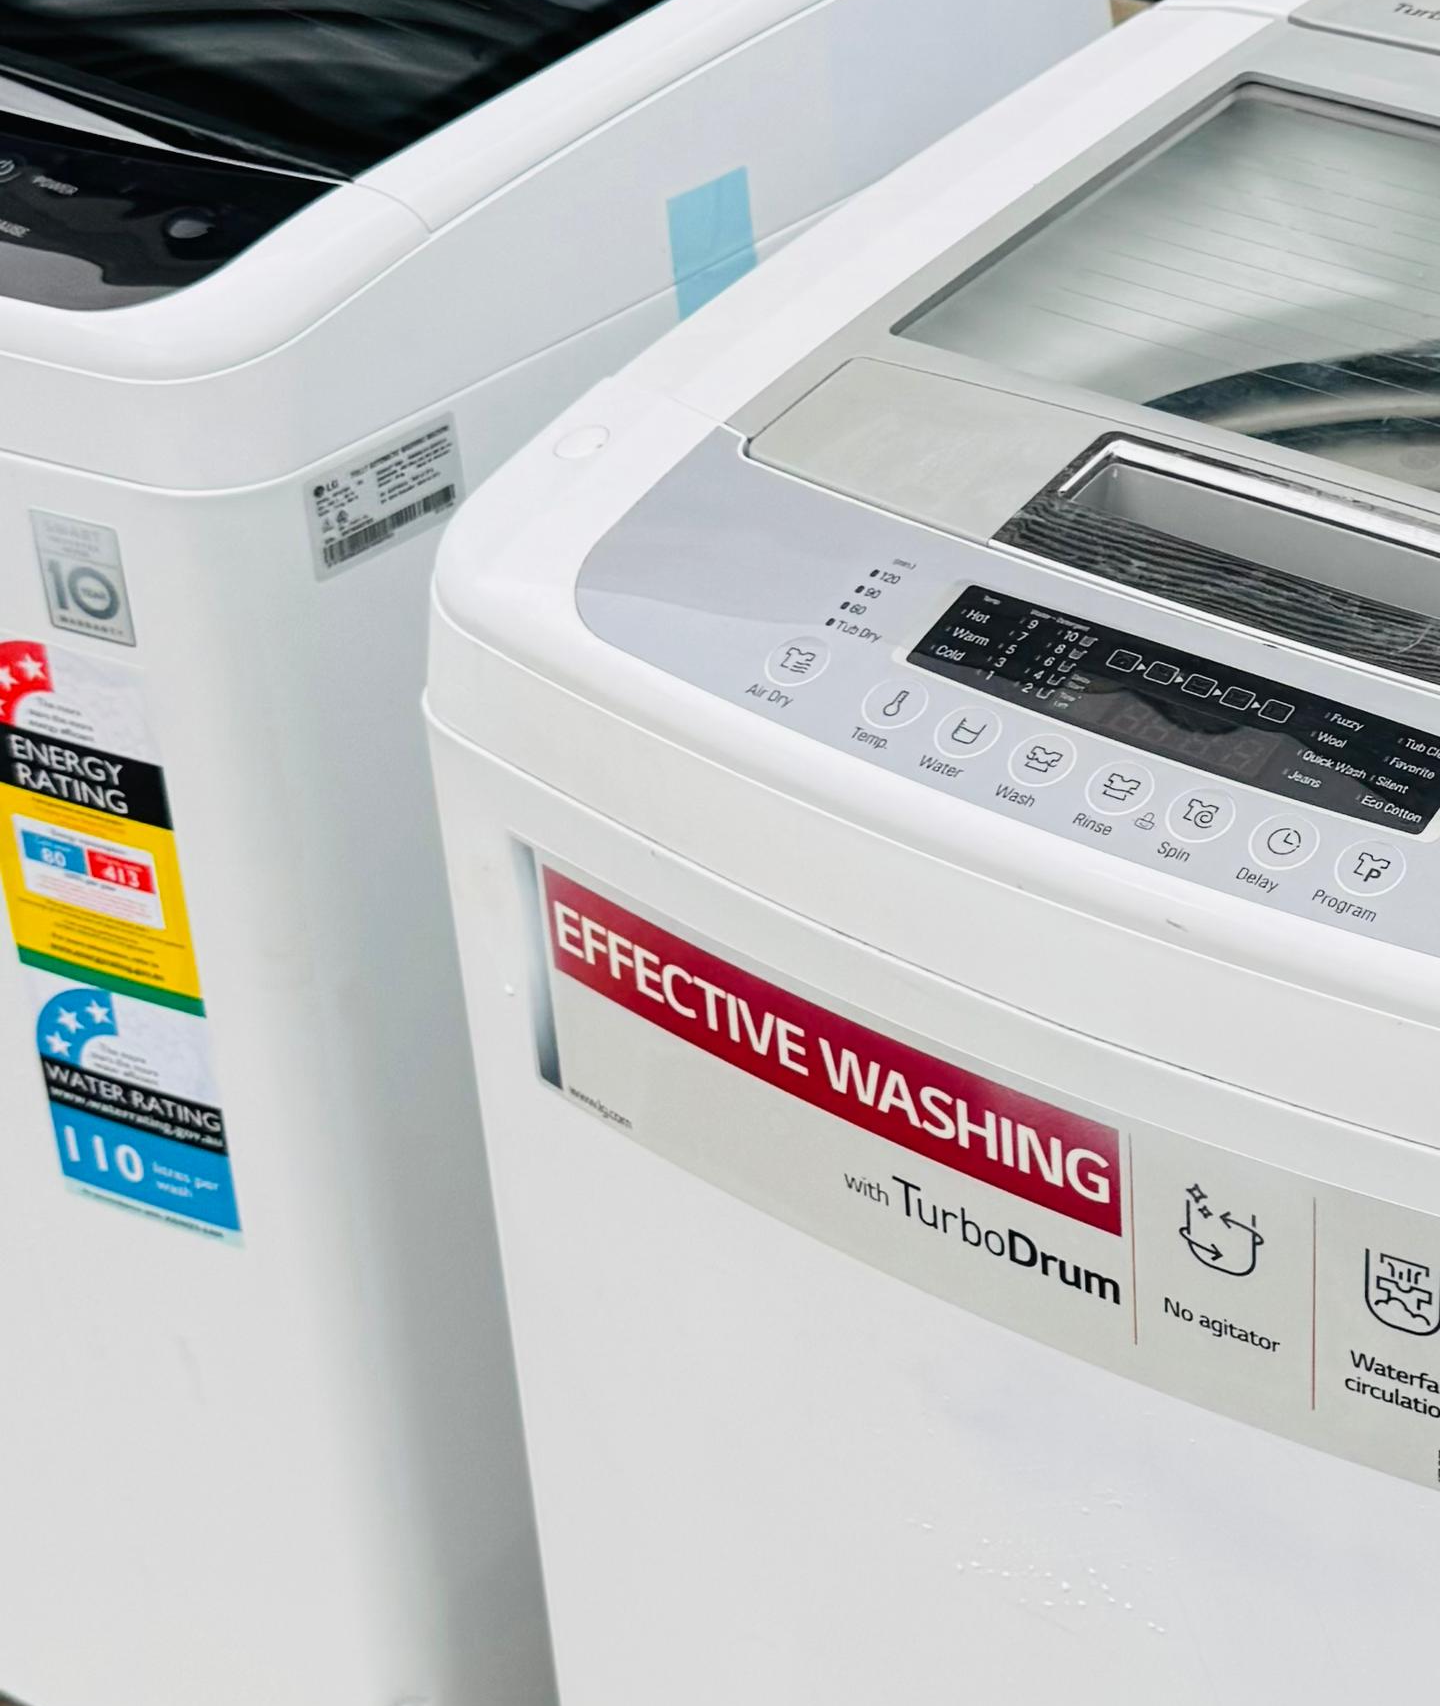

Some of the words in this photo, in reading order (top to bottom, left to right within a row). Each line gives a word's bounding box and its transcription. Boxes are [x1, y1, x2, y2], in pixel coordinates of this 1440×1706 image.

[326, 479, 339, 492] LG
[48, 559, 120, 620] 10
[880, 571, 901, 585] 120
[965, 609, 992, 624] Hot
[1027, 620, 1039, 630] 9
[837, 619, 859, 636] Tub
[858, 627, 883, 644] Dry
[951, 626, 990, 647] Warm
[1016, 631, 1029, 641] 7
[1063, 629, 1080, 642] 10
[935, 644, 966, 662] Cold
[1005, 644, 1018, 655] 5
[1054, 643, 1067, 654] 8
[994, 657, 1007, 668] 3
[1043, 656, 1056, 667] 6
[1033, 670, 1045, 680] 4
[745, 683, 769, 699] Air
[767, 689, 795, 708] Dry
[1021, 682, 1034, 693] 2
[1330, 712, 1366, 732] Fuzzy
[850, 726, 888, 750] Temp.
[1317, 730, 1348, 749] Wool
[1405, 737, 1425, 753] Tub
[10, 733, 123, 786] ENERGY
[918, 754, 965, 779] Water
[1301, 749, 1334, 770] Quick
[1334, 760, 1368, 781] Wash
[1389, 756, 1436, 781] Favorite
[15, 762, 129, 815] RATING
[1286, 770, 1323, 789] Jeans
[1374, 775, 1410, 795] Silent
[994, 783, 1036, 808] Wash
[1360, 794, 1384, 810] Eco
[1383, 803, 1423, 824] Cotton
[1072, 811, 1113, 836] Rinse
[1157, 840, 1192, 863] Spin
[101, 864, 141, 888] 413
[1235, 866, 1280, 893] Delay
[1311, 888, 1378, 923] Program
[552, 899, 810, 1077] EFFECTIVE
[817, 1035, 1112, 1205] WASHING
[44, 1061, 126, 1103] WATER
[130, 1090, 222, 1132] RATING
[64, 1125, 145, 1183] 110
[843, 1172, 890, 1207] with
[891, 1174, 1122, 1306] TurboDrum
[1163, 1296, 1194, 1323] No
[1198, 1309, 1281, 1354] agitator
